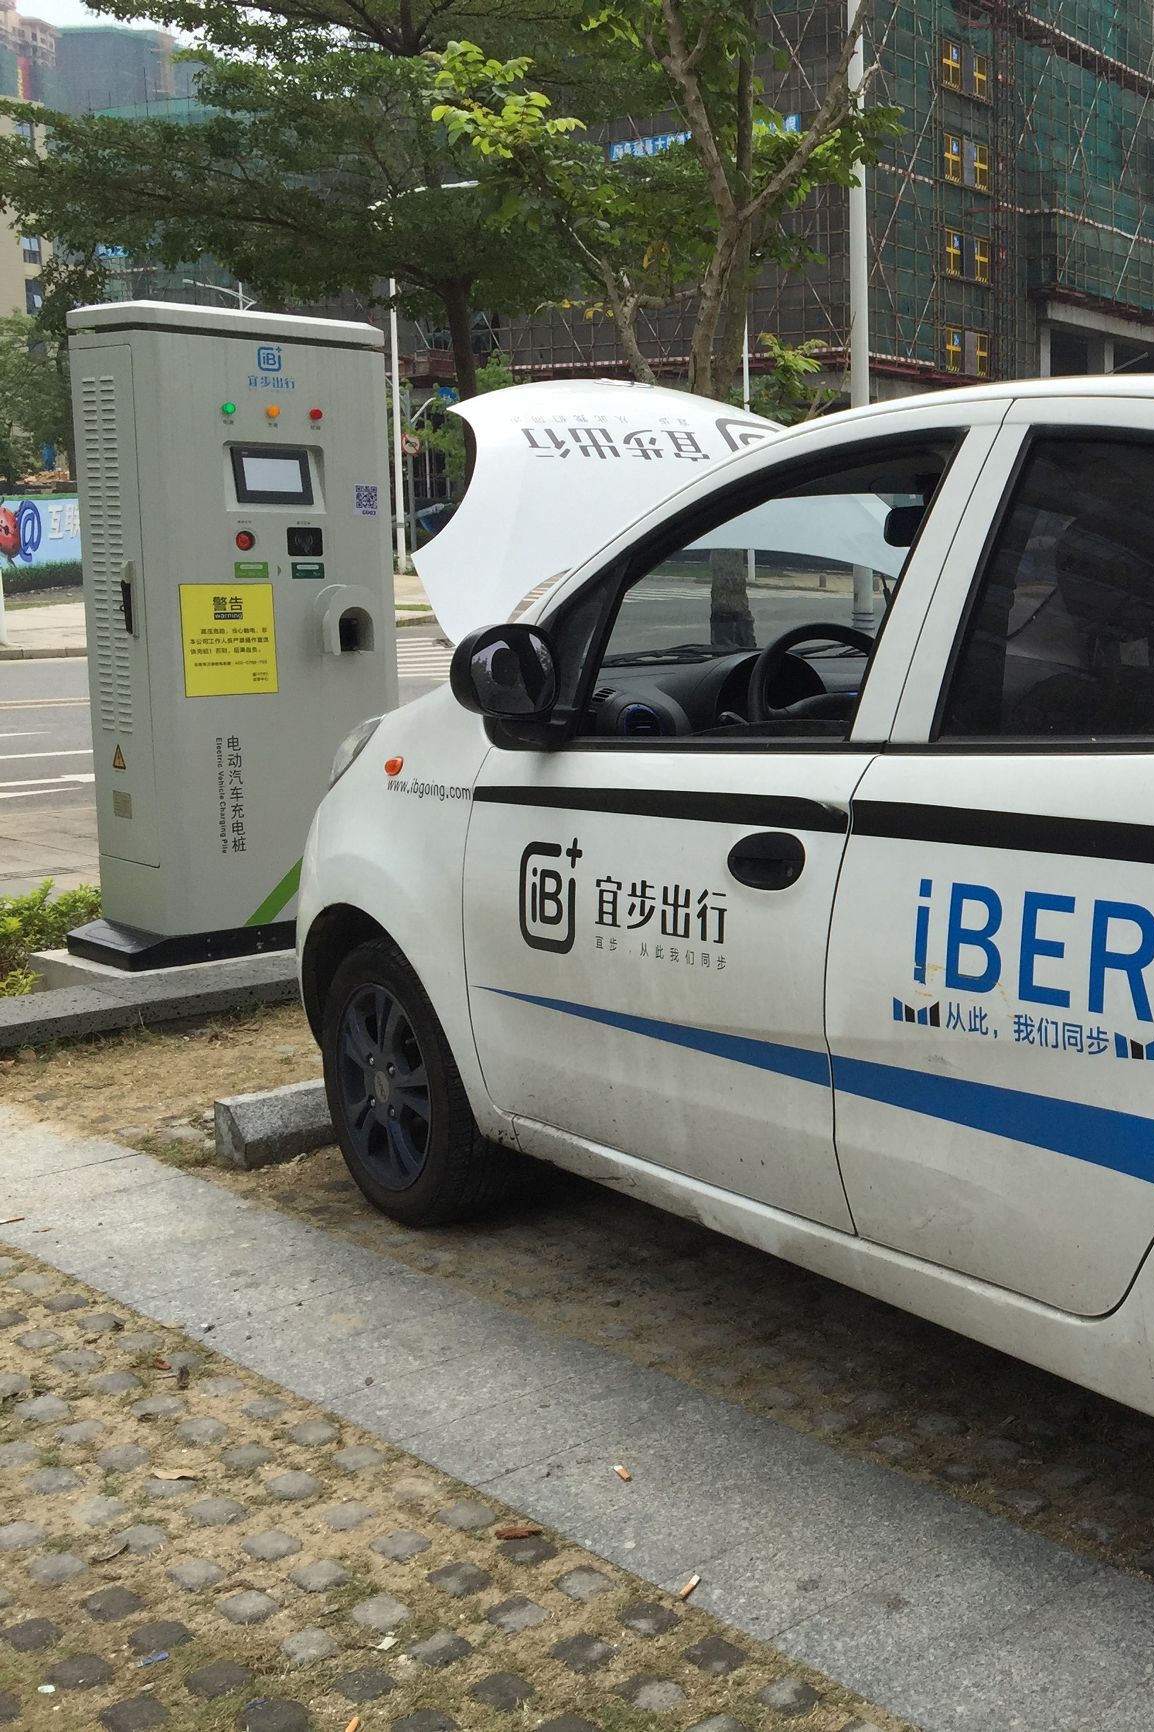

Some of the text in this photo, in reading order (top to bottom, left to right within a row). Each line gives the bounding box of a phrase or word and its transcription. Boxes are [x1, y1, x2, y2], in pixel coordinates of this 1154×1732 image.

[521, 427, 711, 461] 宜步出行
[212, 596, 243, 612] 警告
[214, 612, 243, 620] warning
[227, 735, 247, 853] 电动汽车充电桩
[387, 778, 471, 801] www.ibgoing.com
[219, 801, 227, 838] Charging
[594, 875, 728, 945] 宜步出行
[945, 1001, 1110, 1056] 从此，我们同步
